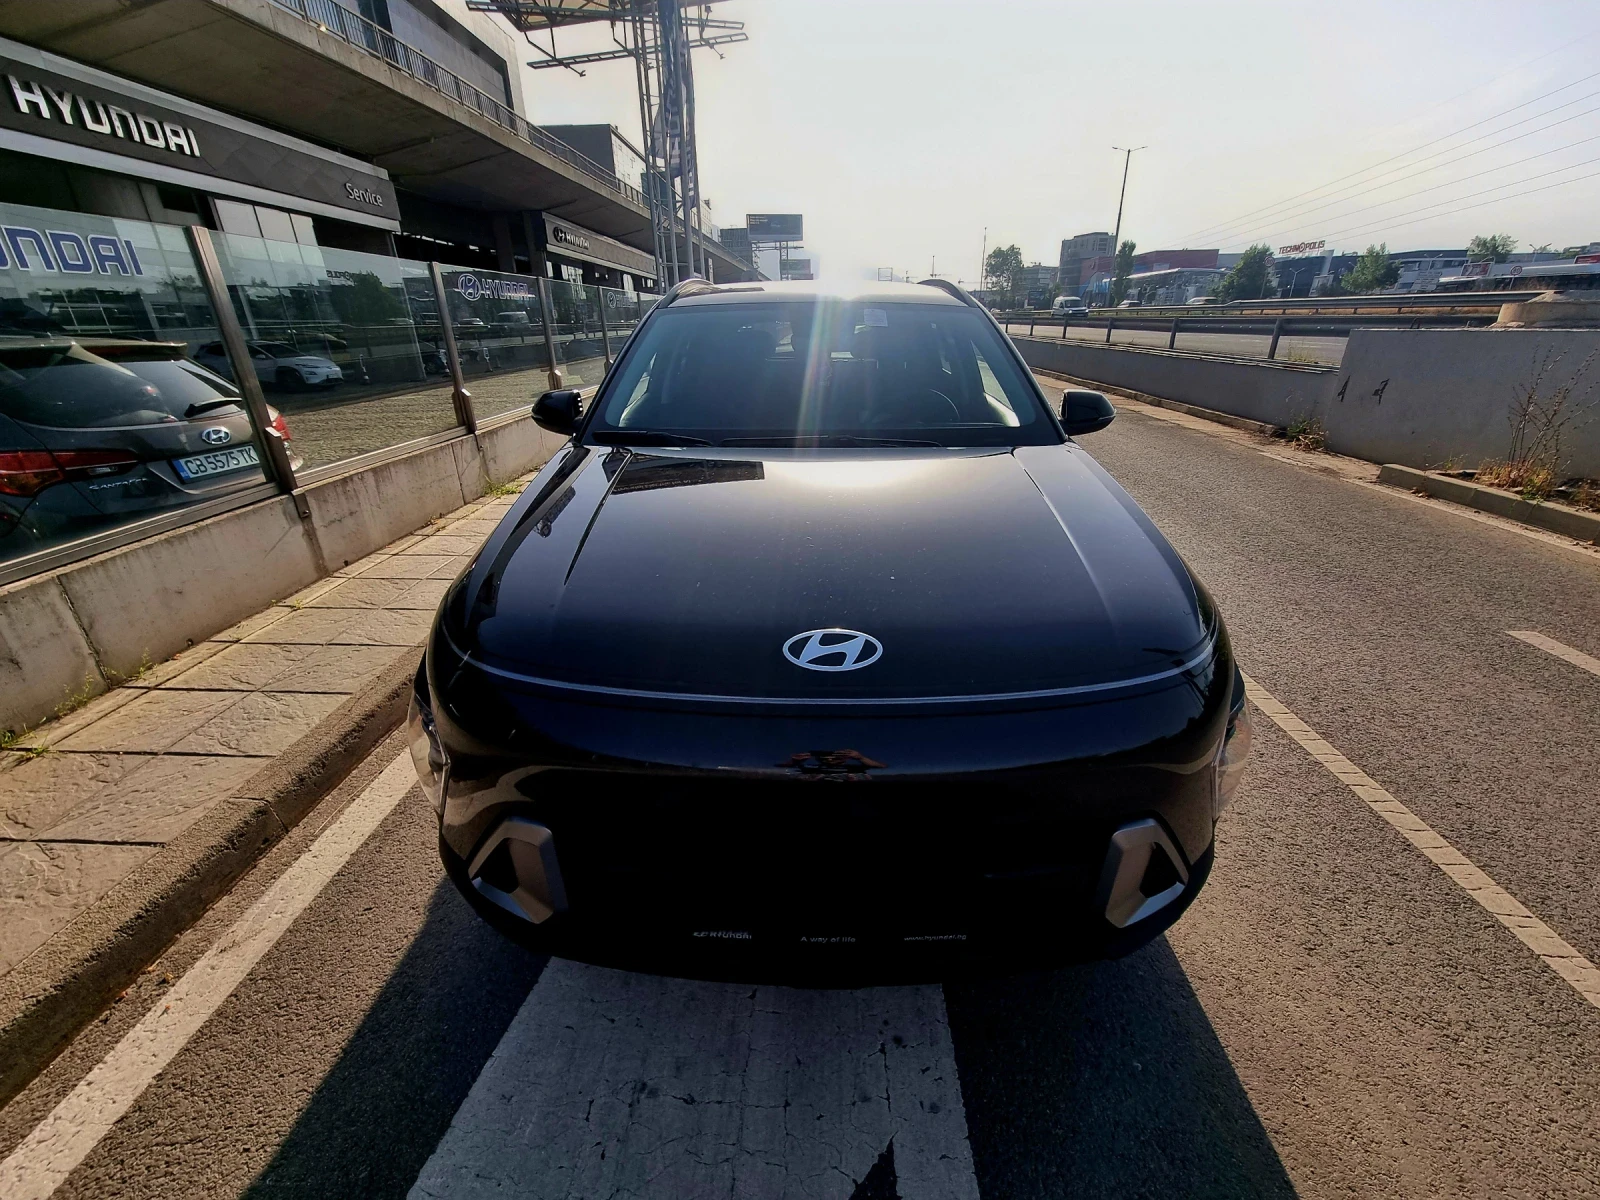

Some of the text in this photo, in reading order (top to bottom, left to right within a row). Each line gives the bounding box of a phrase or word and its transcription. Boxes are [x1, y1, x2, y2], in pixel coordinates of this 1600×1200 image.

[7, 74, 200, 158] HYUNDAI
[346, 182, 383, 208] Service
[0, 223, 144, 276] NDAI
[482, 278, 529, 300] HYUNDAI
[204, 451, 240, 471] 5575
